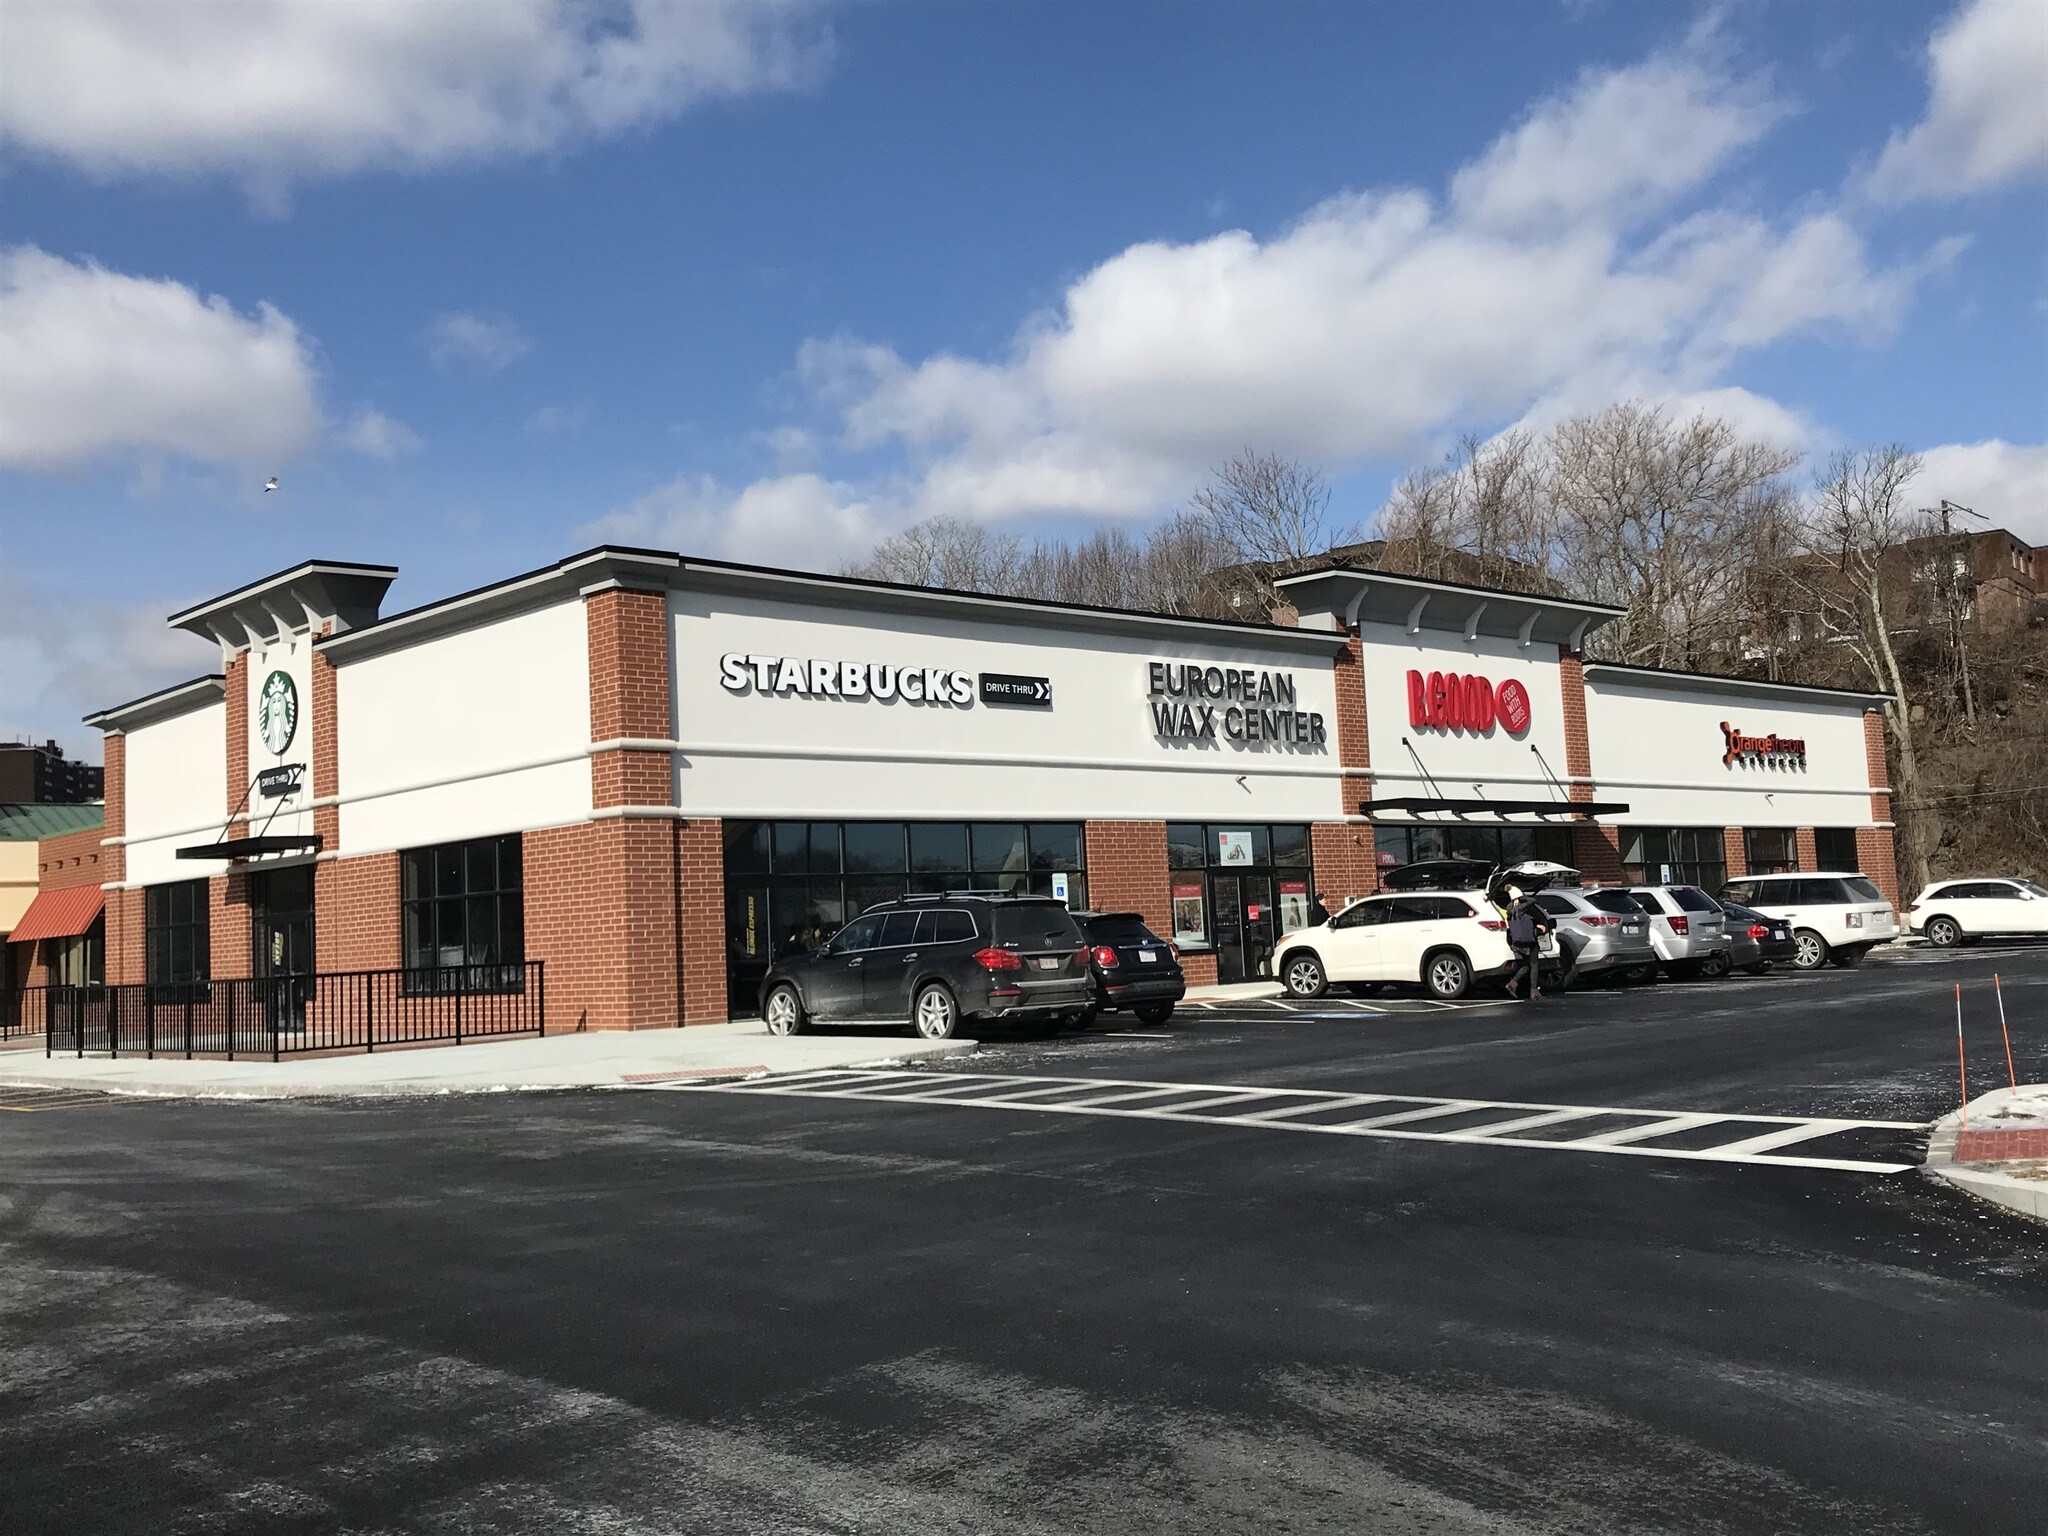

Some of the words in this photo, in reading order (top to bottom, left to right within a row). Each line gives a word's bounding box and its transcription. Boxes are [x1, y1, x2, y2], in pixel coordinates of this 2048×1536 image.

[721, 653, 971, 704] STARBUCKS
[985, 682, 1010, 693] DRIVE
[1012, 684, 1034, 695] THRU
[1149, 662, 1294, 703] EUROPEAN
[1151, 702, 1216, 738] WAX
[1224, 707, 1325, 744] CENTER
[261, 776, 275, 787] DRIVE
[275, 773, 288, 784] THRU
